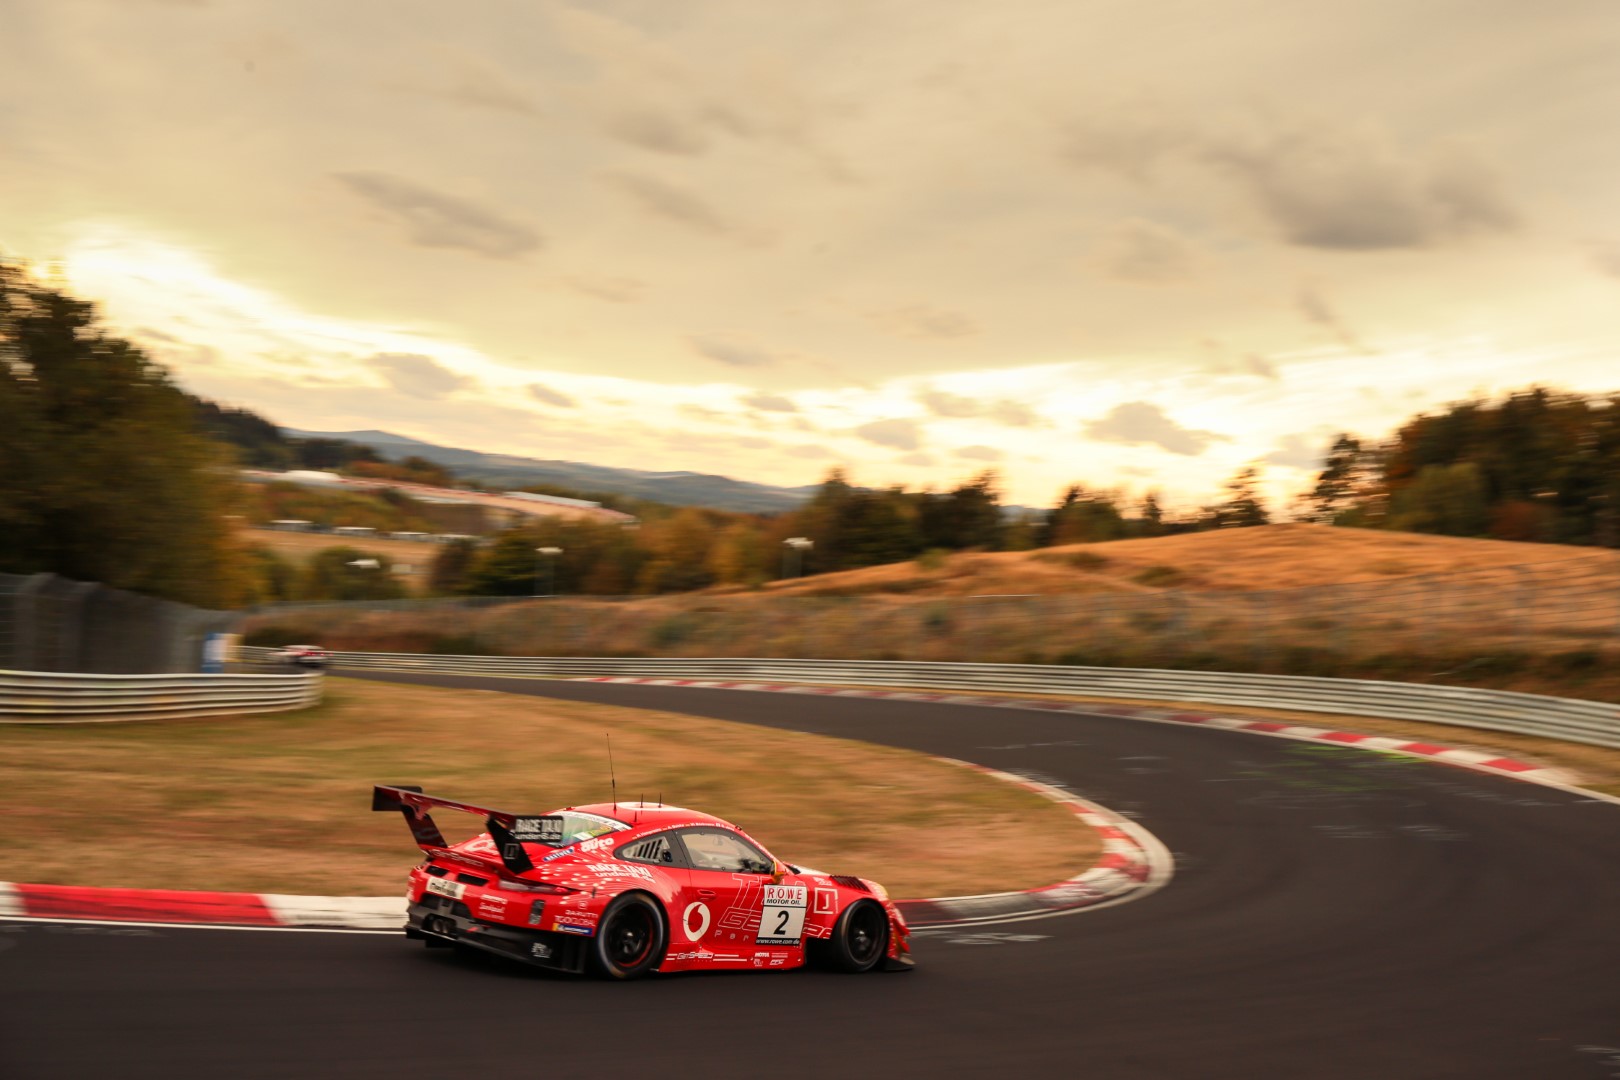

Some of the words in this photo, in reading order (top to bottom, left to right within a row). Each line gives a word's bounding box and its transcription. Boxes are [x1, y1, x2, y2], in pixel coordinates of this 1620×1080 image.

[515, 819, 541, 833] RACE
[541, 819, 562, 833] TAXI
[586, 864, 622, 873] RACE
[621, 864, 653, 878] TAXI
[767, 888, 802, 900] ROWE
[773, 910, 790, 935] 2
